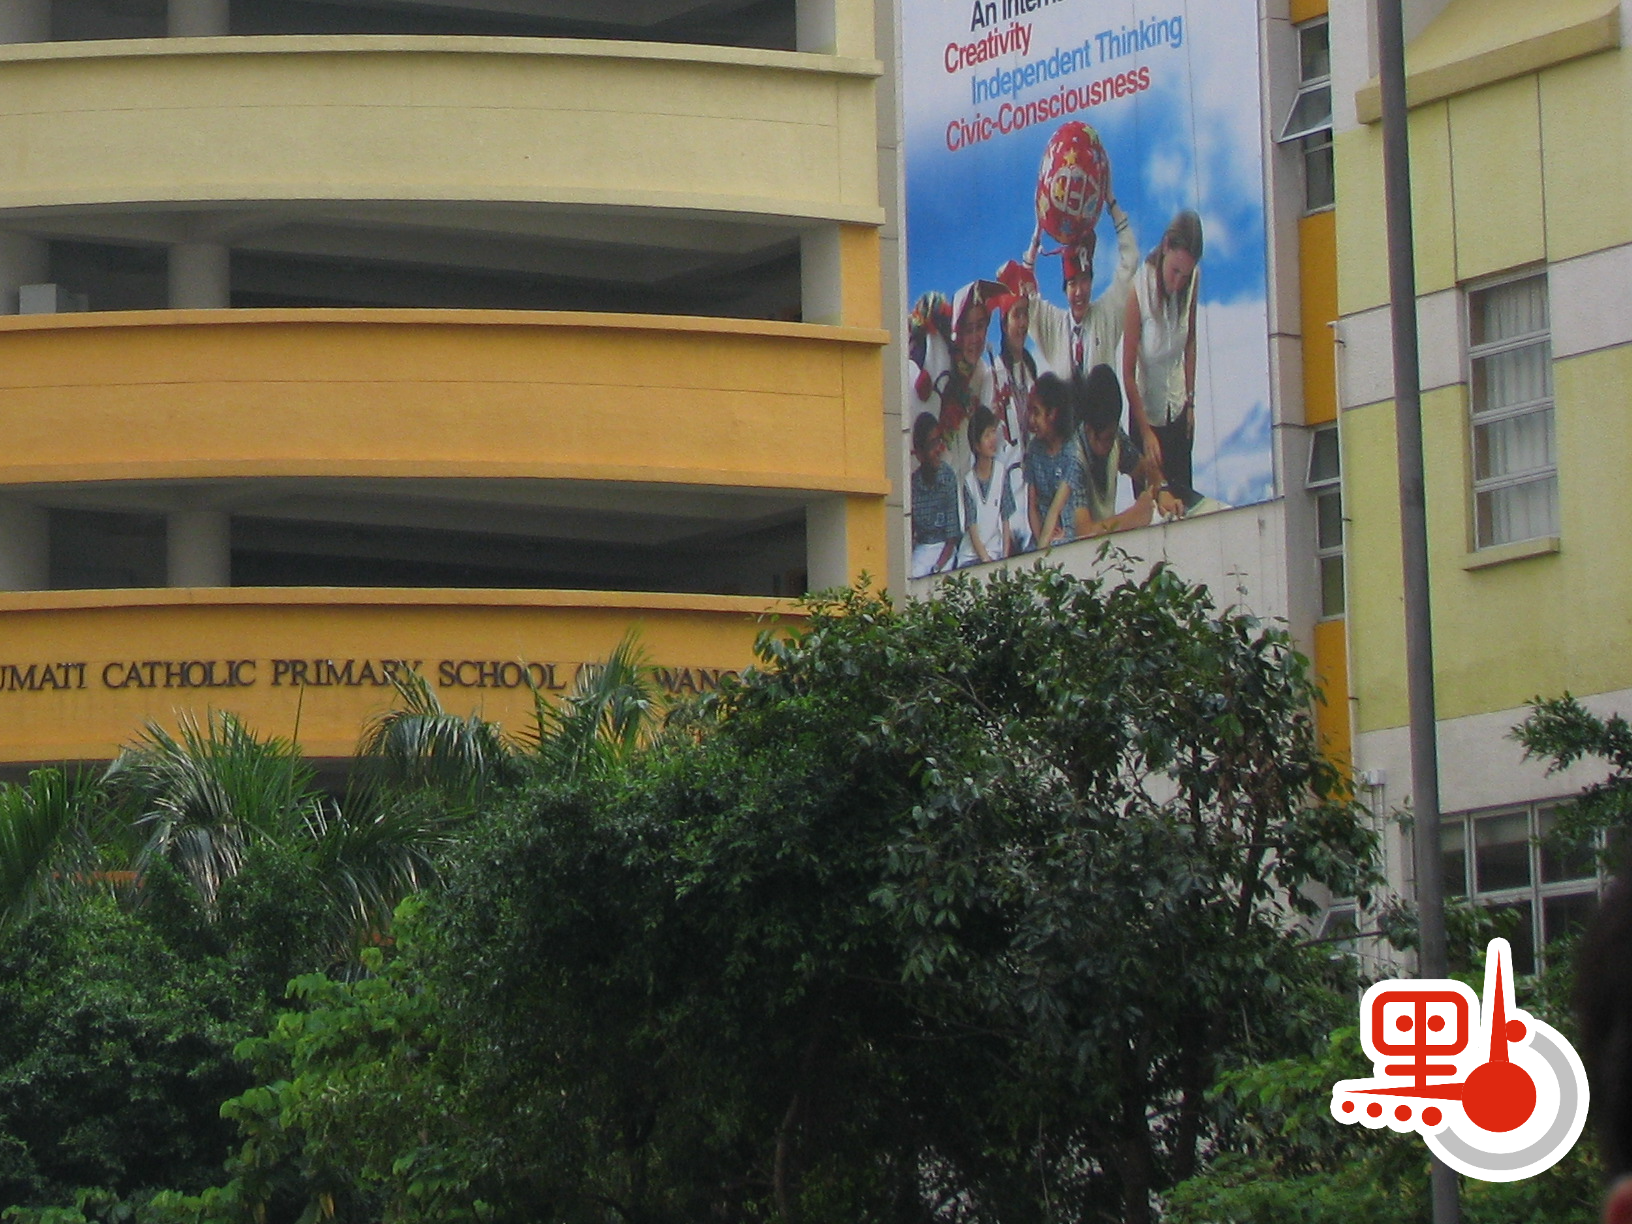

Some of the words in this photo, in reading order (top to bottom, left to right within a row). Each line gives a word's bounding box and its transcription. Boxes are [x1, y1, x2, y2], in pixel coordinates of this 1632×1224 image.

[970, 0, 997, 32] An
[944, 21, 1032, 73] Creativity
[972, 40, 1091, 104] Independent
[1095, 15, 1183, 63] Thinking
[946, 66, 1151, 152] Civic-Consciousness
[102, 659, 256, 689] CATHOLIC
[270, 659, 423, 687] PRIMARY
[438, 660, 567, 690] SCHOOL
